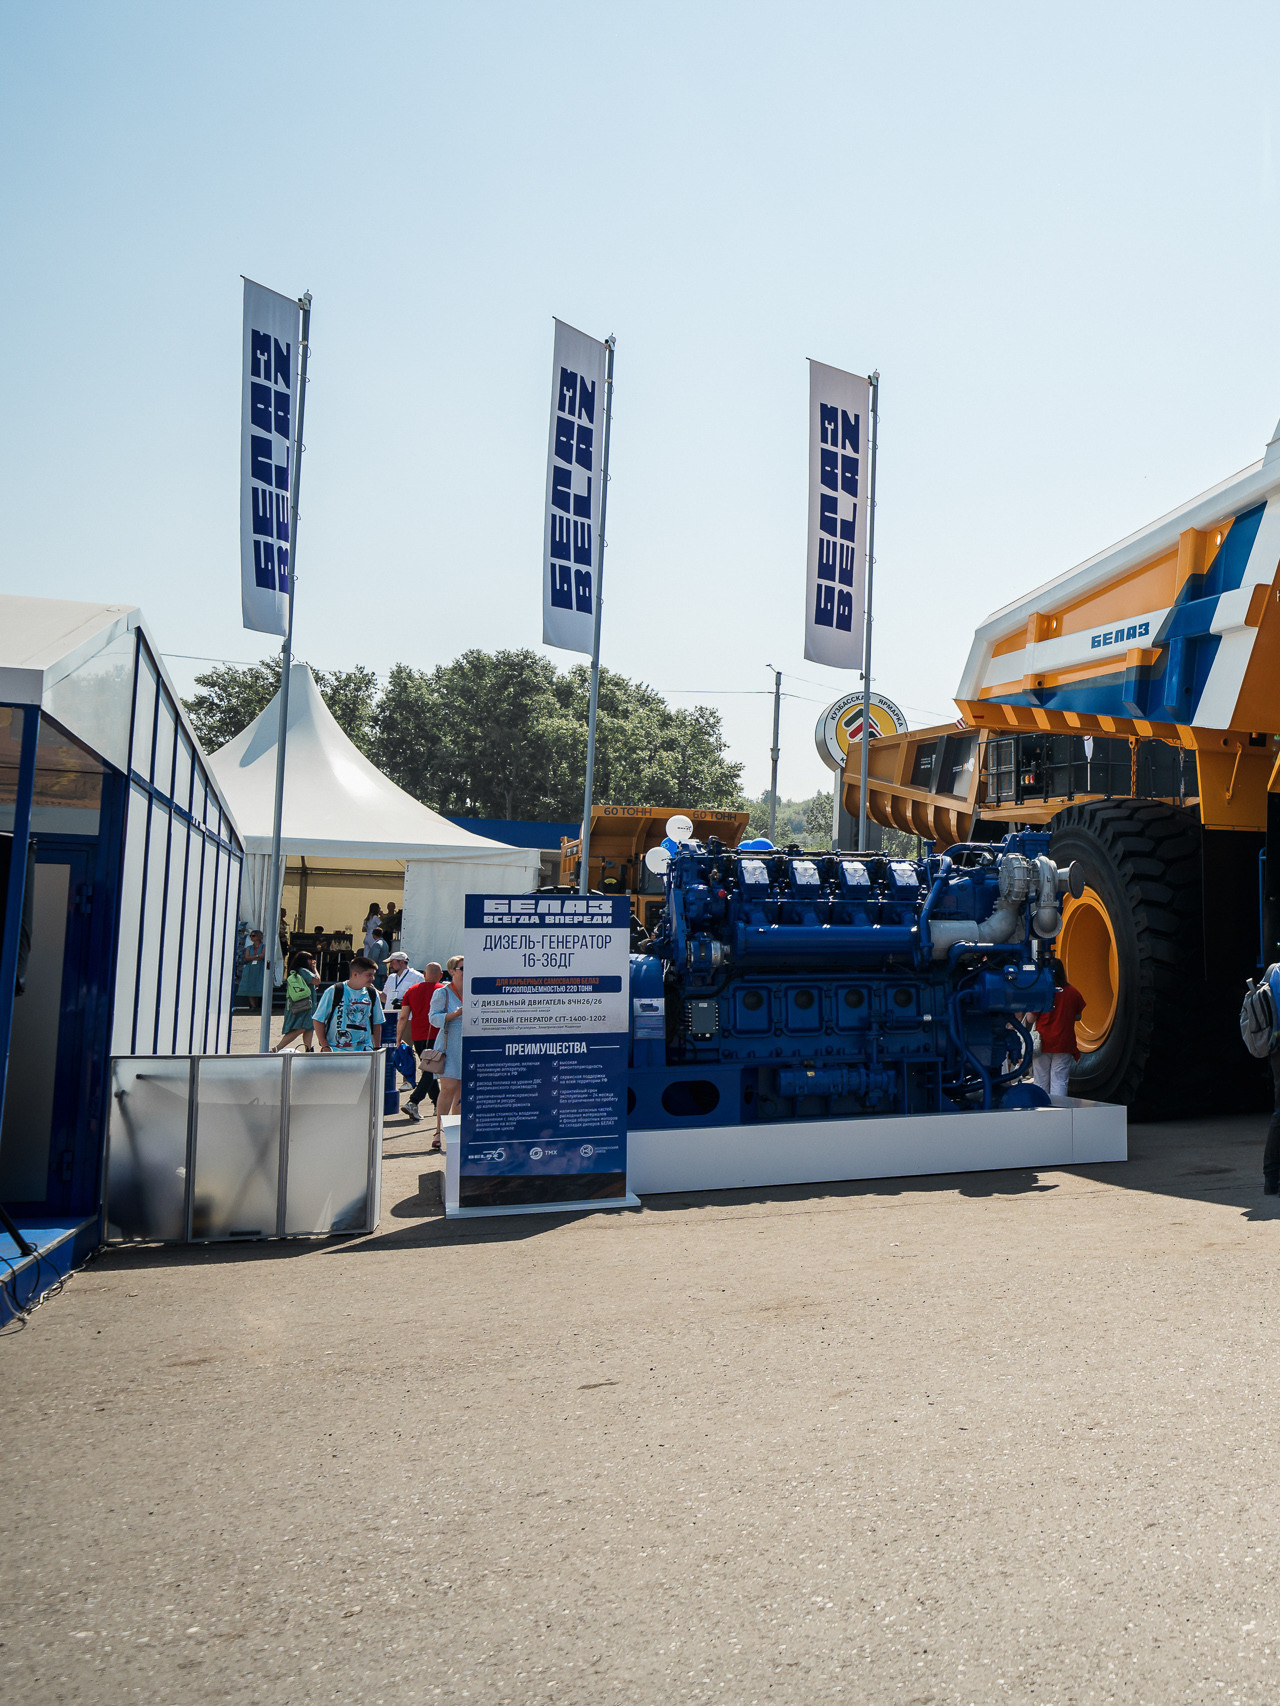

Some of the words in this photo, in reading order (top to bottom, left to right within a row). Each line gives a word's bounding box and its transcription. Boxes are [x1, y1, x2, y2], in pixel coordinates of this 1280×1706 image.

[250, 328, 276, 590] БЕЛАЗ
[273, 336, 290, 595] BELAZ
[550, 366, 578, 610] БЕЛАЗ
[573, 375, 596, 615] BELAZ
[814, 402, 839, 628] БЕЛАЗ
[835, 409, 860, 632] BELAZ
[1091, 622, 1150, 649] БЕЛАЗ
[830, 695, 865, 720] КУЗБАССКА
[877, 698, 904, 727] ЯРМАРКА
[604, 807, 618, 815] 60
[620, 807, 652, 816] ТОНН
[692, 810, 706, 819] 60
[710, 812, 737, 821] ТОНН
[484, 900, 613, 914] БЕЛАЗ
[483, 916, 540, 924] ВСЕГДА
[545, 916, 612, 924] ВПЕРЕДИ
[483, 934, 612, 951] ДИЗЕЛЬ-ГЕНЕРАТОР
[522, 953, 575, 969] 16-36ДГ
[496, 978, 508, 986] ДЛЯ
[509, 978, 543, 986] КАРЬЕРНЫХ
[543, 977, 580, 985] САМОСВАЛОВ
[581, 977, 599, 985] БЕЛАЗ
[502, 986, 566, 994] ГРУЗОПОДЪЕМНОСТЬЮ
[481, 998, 526, 1007] ДИЗЕЛЬНЫЙ
[527, 999, 566, 1007] ДВИГАТЕЛЬ
[567, 998, 603, 1006] 8ЧН26/26
[481, 1016, 514, 1024] ТЯГОВЫЙ
[505, 1042, 587, 1055] ПРЕИМУЩЕСТВА
